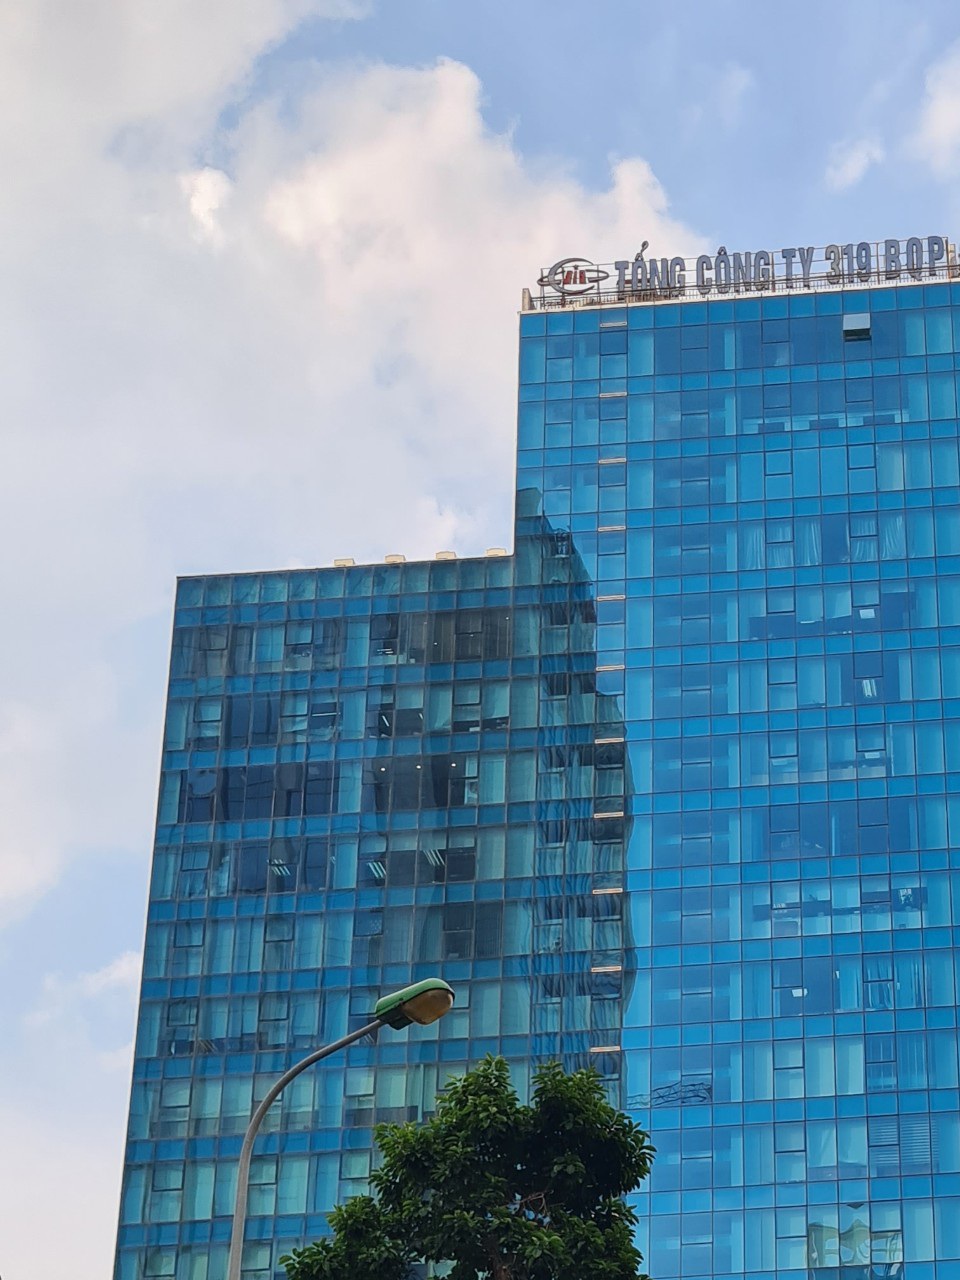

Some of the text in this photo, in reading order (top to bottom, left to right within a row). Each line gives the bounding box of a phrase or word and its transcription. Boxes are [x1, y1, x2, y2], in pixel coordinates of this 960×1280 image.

[614, 235, 945, 300] TỔNG CÔNG TY 319 BQP
